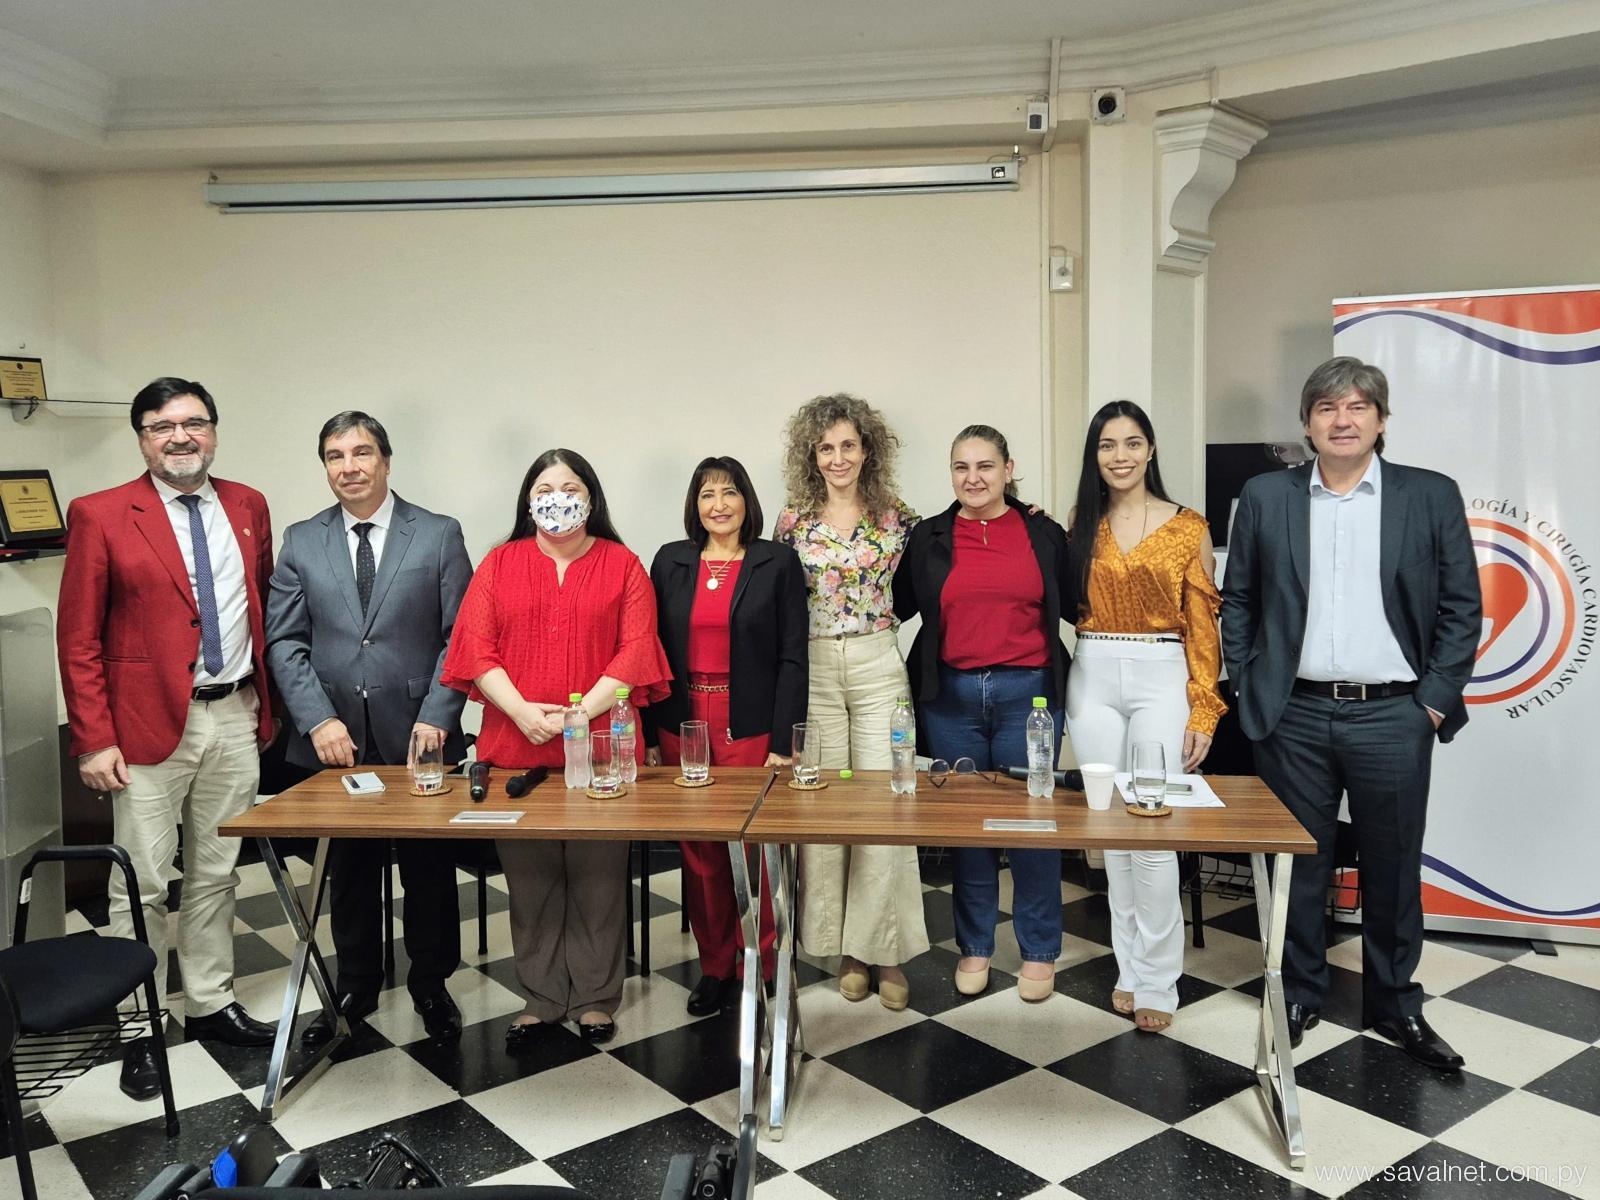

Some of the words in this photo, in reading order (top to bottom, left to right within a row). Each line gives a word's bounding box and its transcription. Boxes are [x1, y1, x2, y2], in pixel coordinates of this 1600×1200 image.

[1523, 510, 1537, 523] Y
[1536, 520, 1592, 584] CIRUGÍA
[1506, 588, 1598, 719] CARDIOVASCULAR
